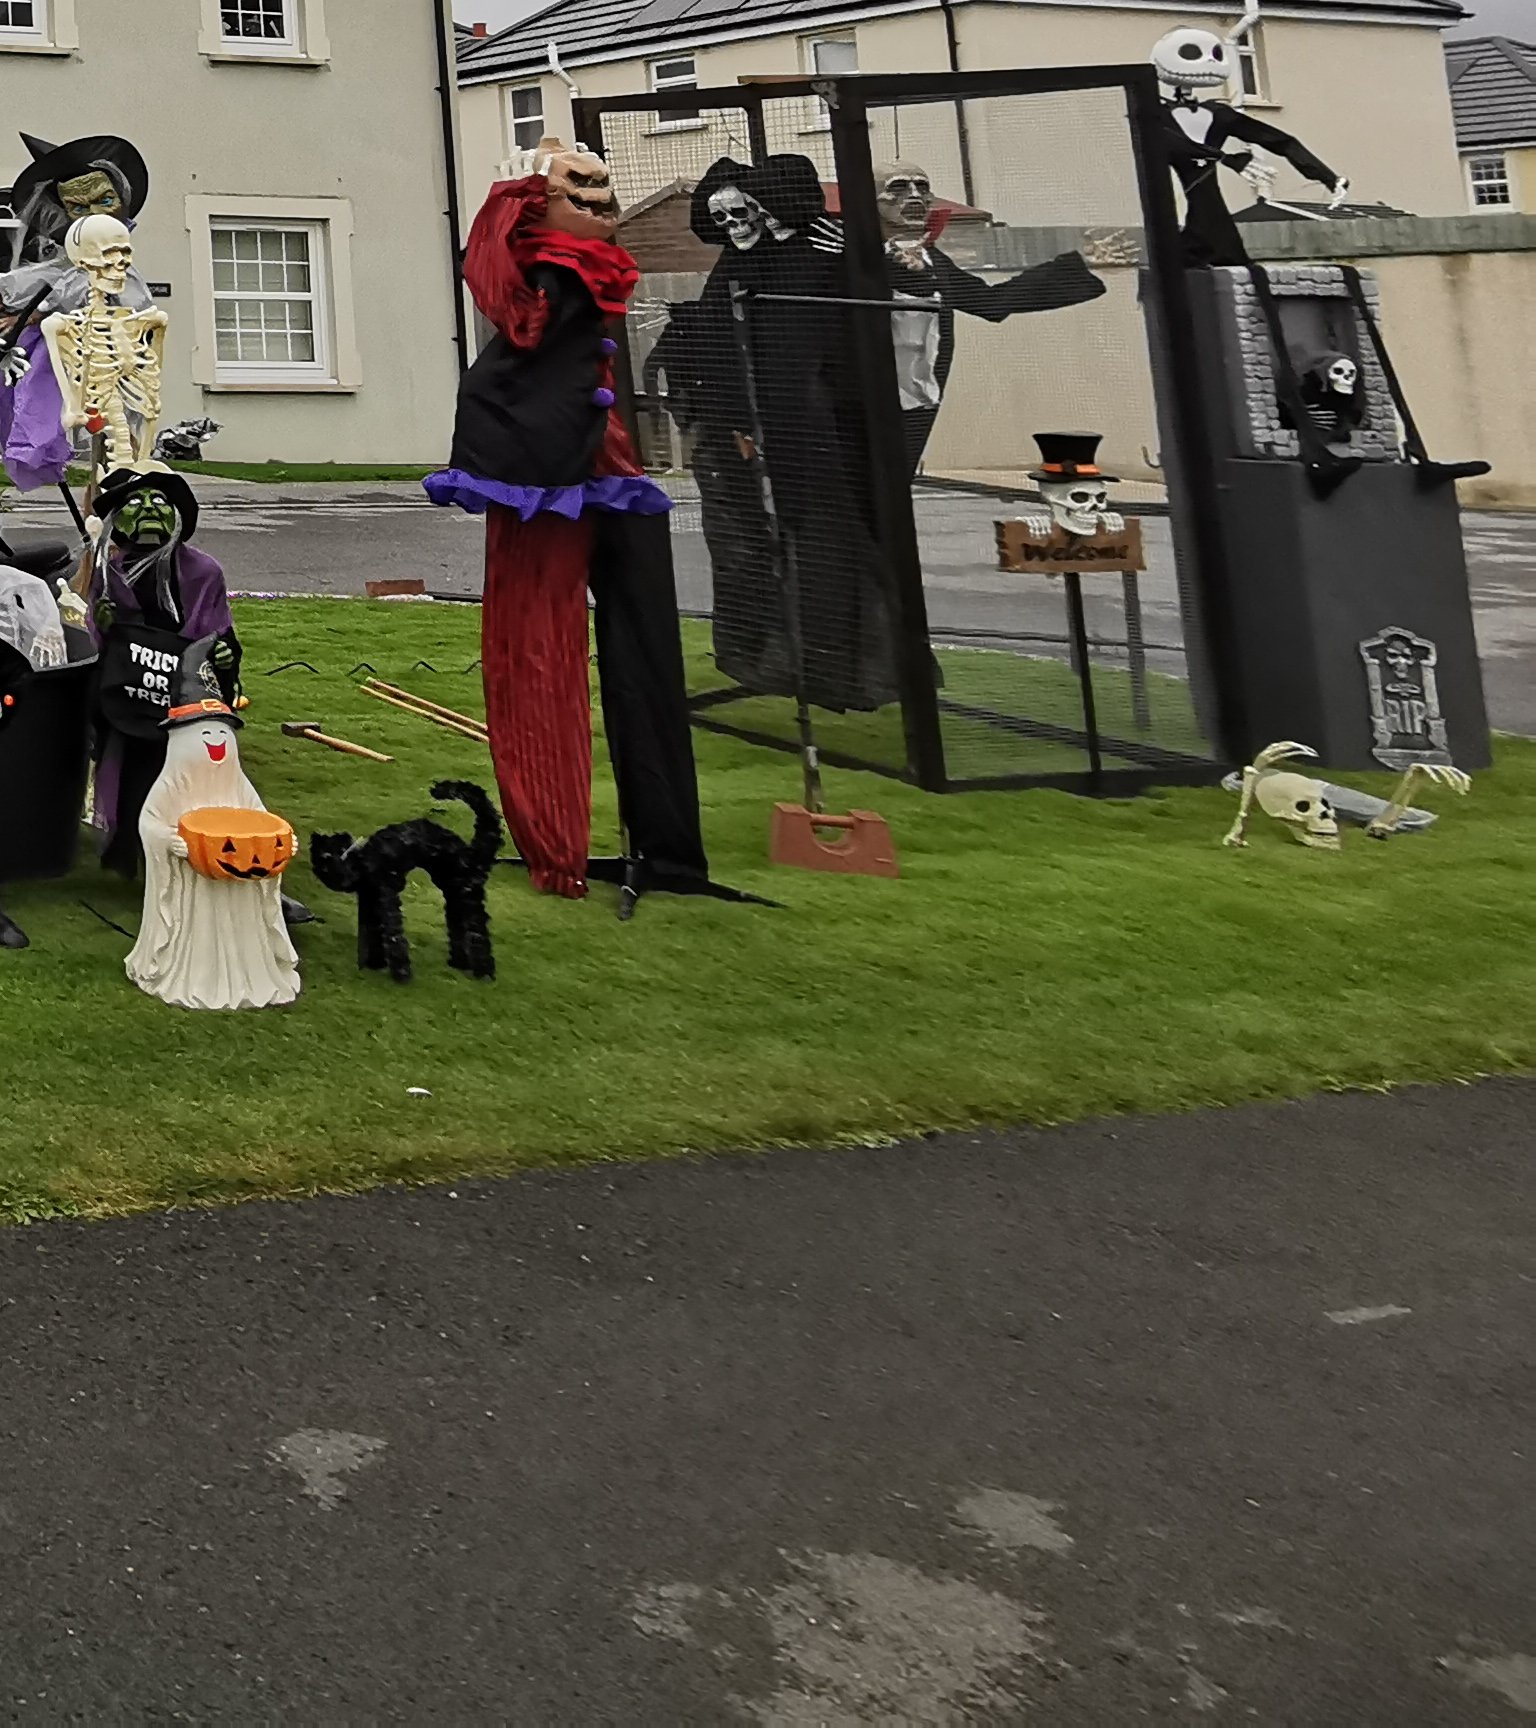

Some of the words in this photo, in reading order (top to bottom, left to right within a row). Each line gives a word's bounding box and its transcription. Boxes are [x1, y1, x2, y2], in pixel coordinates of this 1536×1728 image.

[142, 671, 169, 692] OR
[124, 685, 172, 708] TREA
[1384, 698, 1426, 734] RIP
